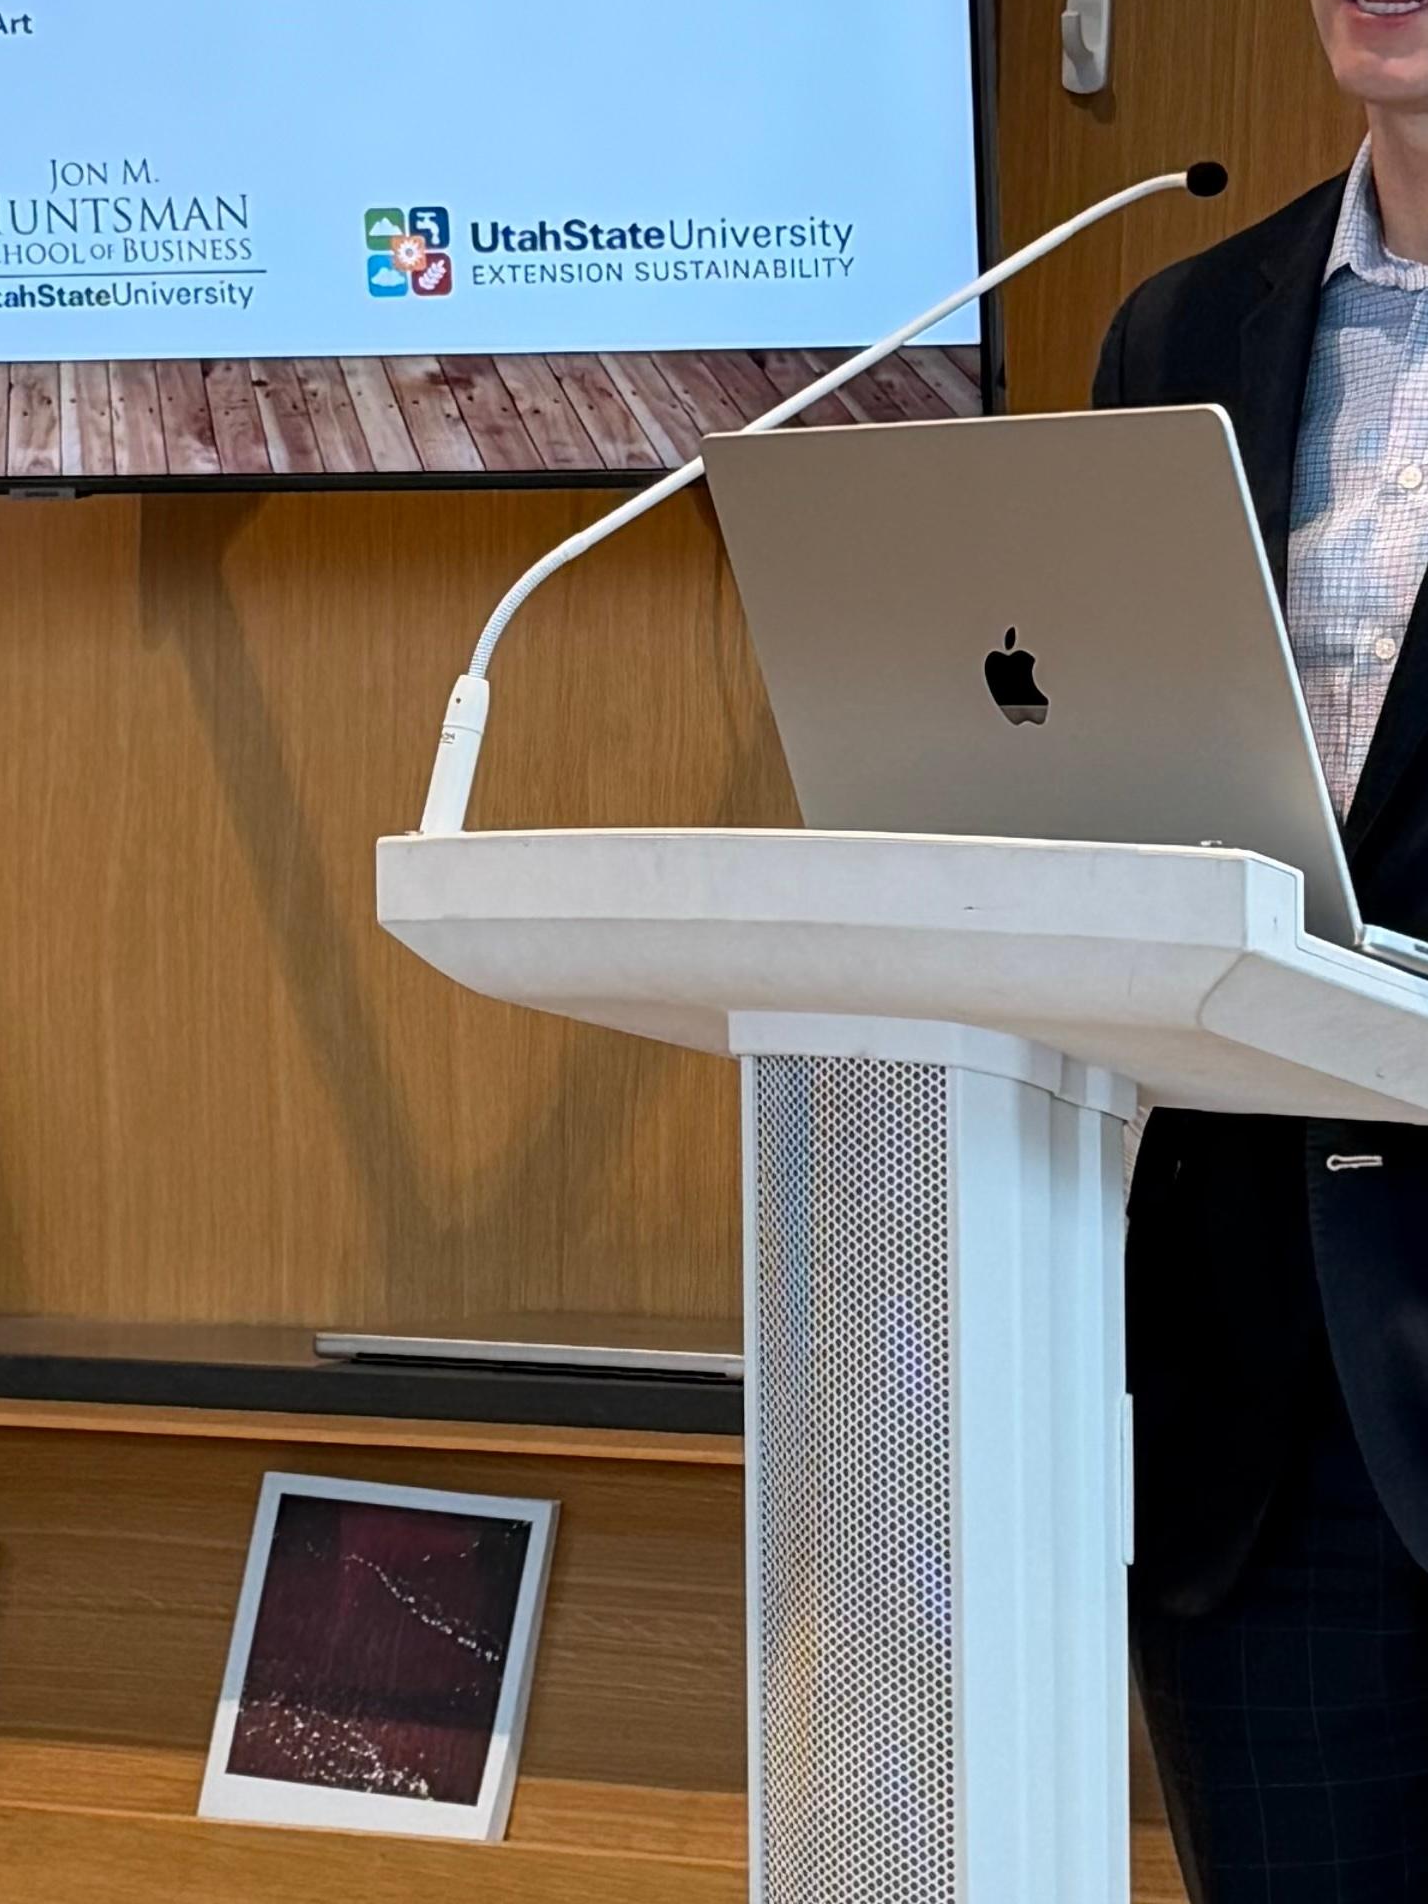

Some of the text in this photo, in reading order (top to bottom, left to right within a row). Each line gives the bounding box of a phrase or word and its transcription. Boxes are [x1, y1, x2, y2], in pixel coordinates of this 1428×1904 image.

[50, 158, 160, 193] JON M.
[471, 216, 854, 253] UtahStateUniversity
[473, 257, 854, 285] EXTENSION SUSTAINABILITY
